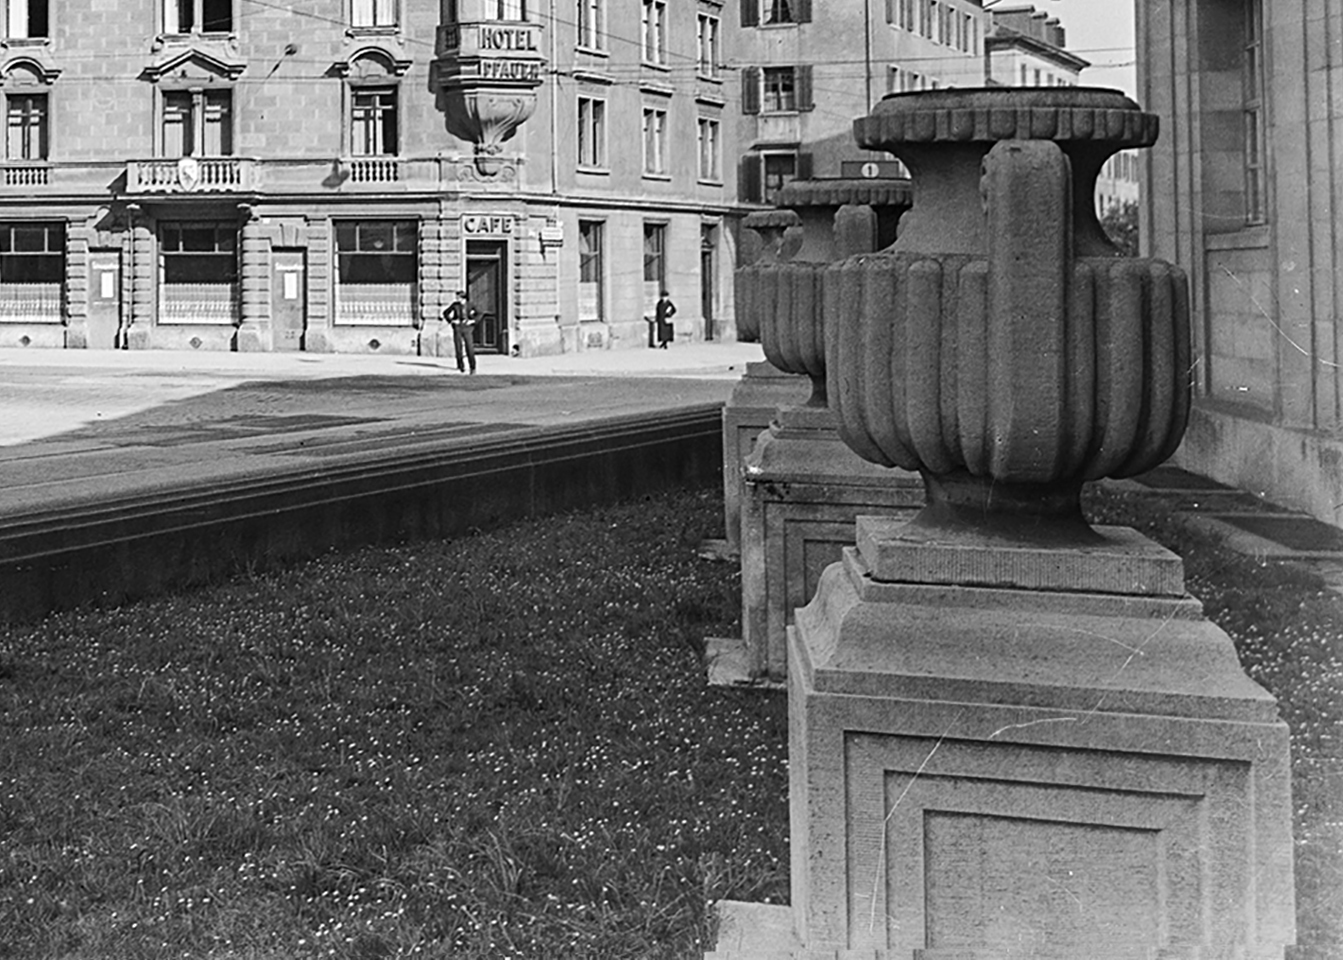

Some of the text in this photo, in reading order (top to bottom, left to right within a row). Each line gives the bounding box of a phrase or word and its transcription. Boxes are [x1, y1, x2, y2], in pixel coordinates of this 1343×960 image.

[481, 28, 537, 51] HOTEL
[482, 61, 539, 80] PFAUEN
[464, 217, 512, 233] CAFE
